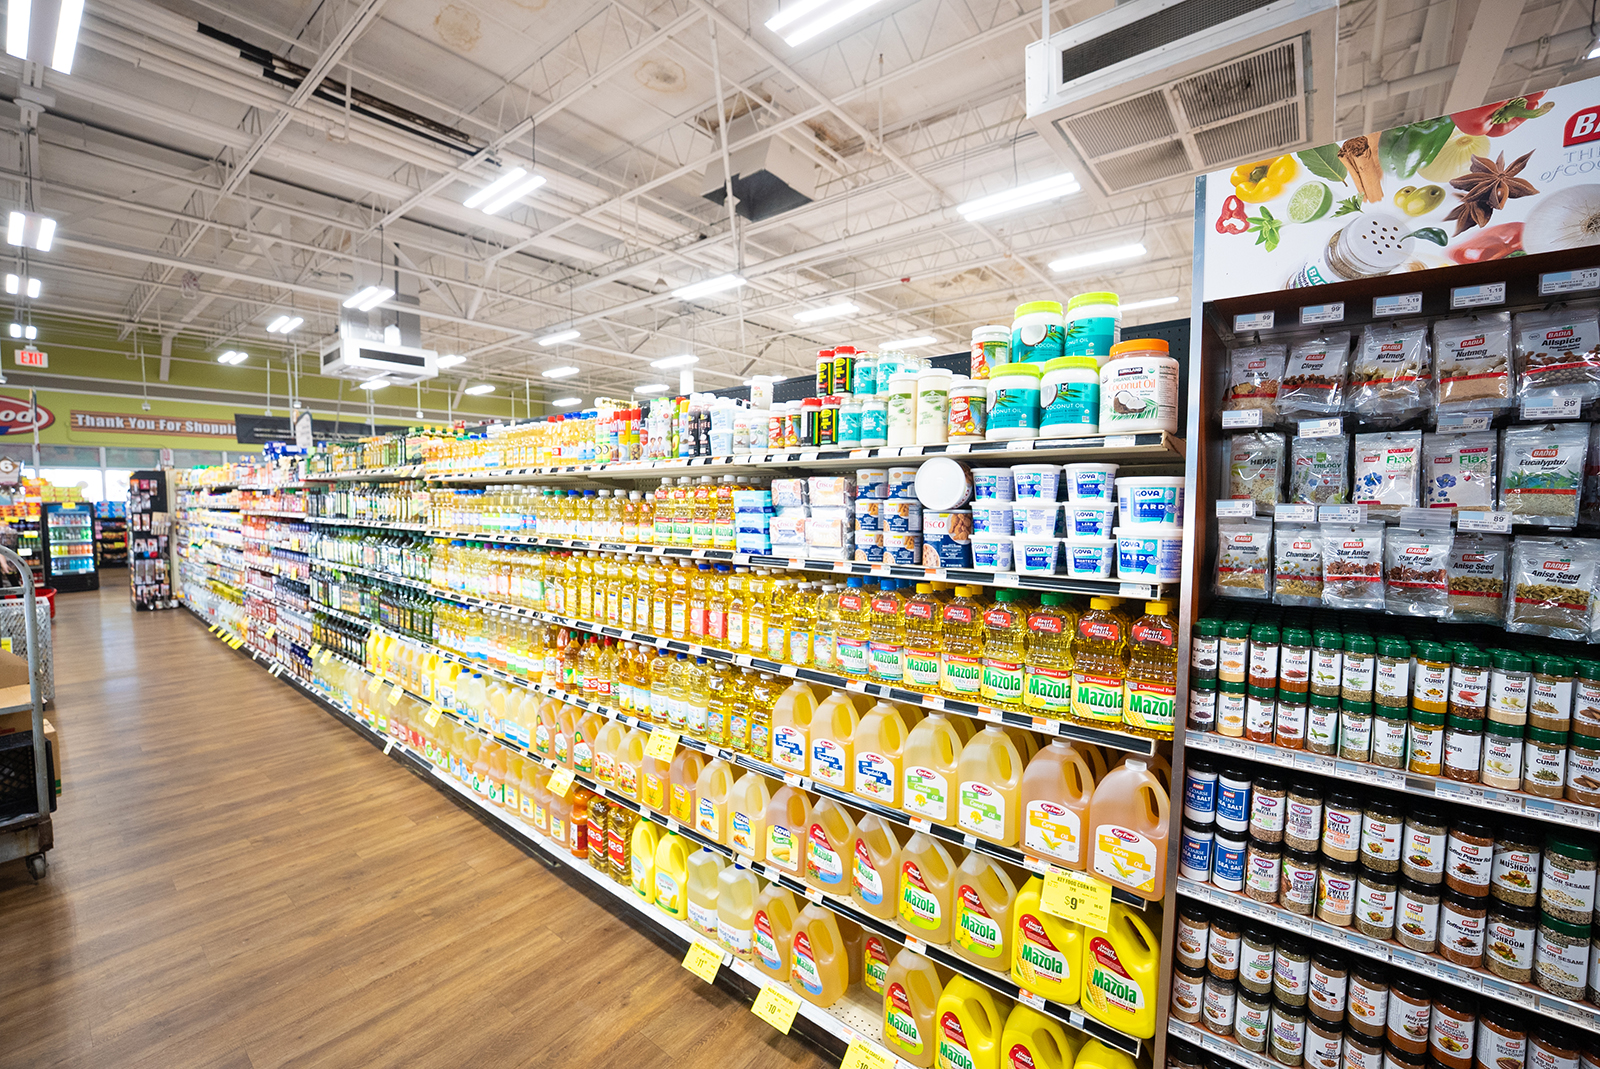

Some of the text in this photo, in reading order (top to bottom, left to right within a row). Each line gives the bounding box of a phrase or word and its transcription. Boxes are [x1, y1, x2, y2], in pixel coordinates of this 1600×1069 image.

[1461, 339, 1483, 347] BADIA
[1542, 336, 1581, 346] Allspice
[21, 351, 43, 365] EXIT
[1456, 349, 1487, 358] Nutmeg
[1109, 379, 1156, 392] Coconut Oil
[76, 414, 124, 428] Thank
[129, 418, 156, 430] You
[160, 419, 182, 431] For
[1460, 455, 1487, 463] Flax
[1, 460, 14, 472] 6
[1531, 570, 1555, 578] Anise
[1139, 632, 1166, 640] Healthy
[841, 646, 862, 658] Mazola
[874, 652, 898, 664] Mazola
[907, 658, 937, 673] Mazola
[947, 665, 979, 680] Mazola
[983, 671, 1021, 690] Mazola
[1029, 678, 1070, 698] Mazola
[1534, 690, 1556, 698] CUMIN
[1078, 687, 1123, 708] Mazola
[1412, 737, 1433, 746] CURRY
[1489, 750, 1511, 759] ONION
[701, 798, 713, 809] GOYA
[1197, 794, 1211, 802] SALT
[1227, 802, 1242, 810] SALT
[736, 812, 749, 824] GOYA
[774, 826, 791, 837] GOYA
[1041, 821, 1056, 830] Corn
[813, 846, 832, 862] Mazola
[1112, 847, 1129, 857] Corn
[1192, 852, 1207, 861] SALT
[1512, 854, 1529, 863] BADIA
[1500, 859, 1536, 873] MUSHROOM
[904, 888, 935, 914] Mazola
[961, 914, 996, 941] Mazola
[1022, 944, 1062, 974] Mazola
[1092, 969, 1137, 1004] Mazola
[887, 1011, 917, 1040] Mazola
[940, 1041, 973, 1069] Mazola
